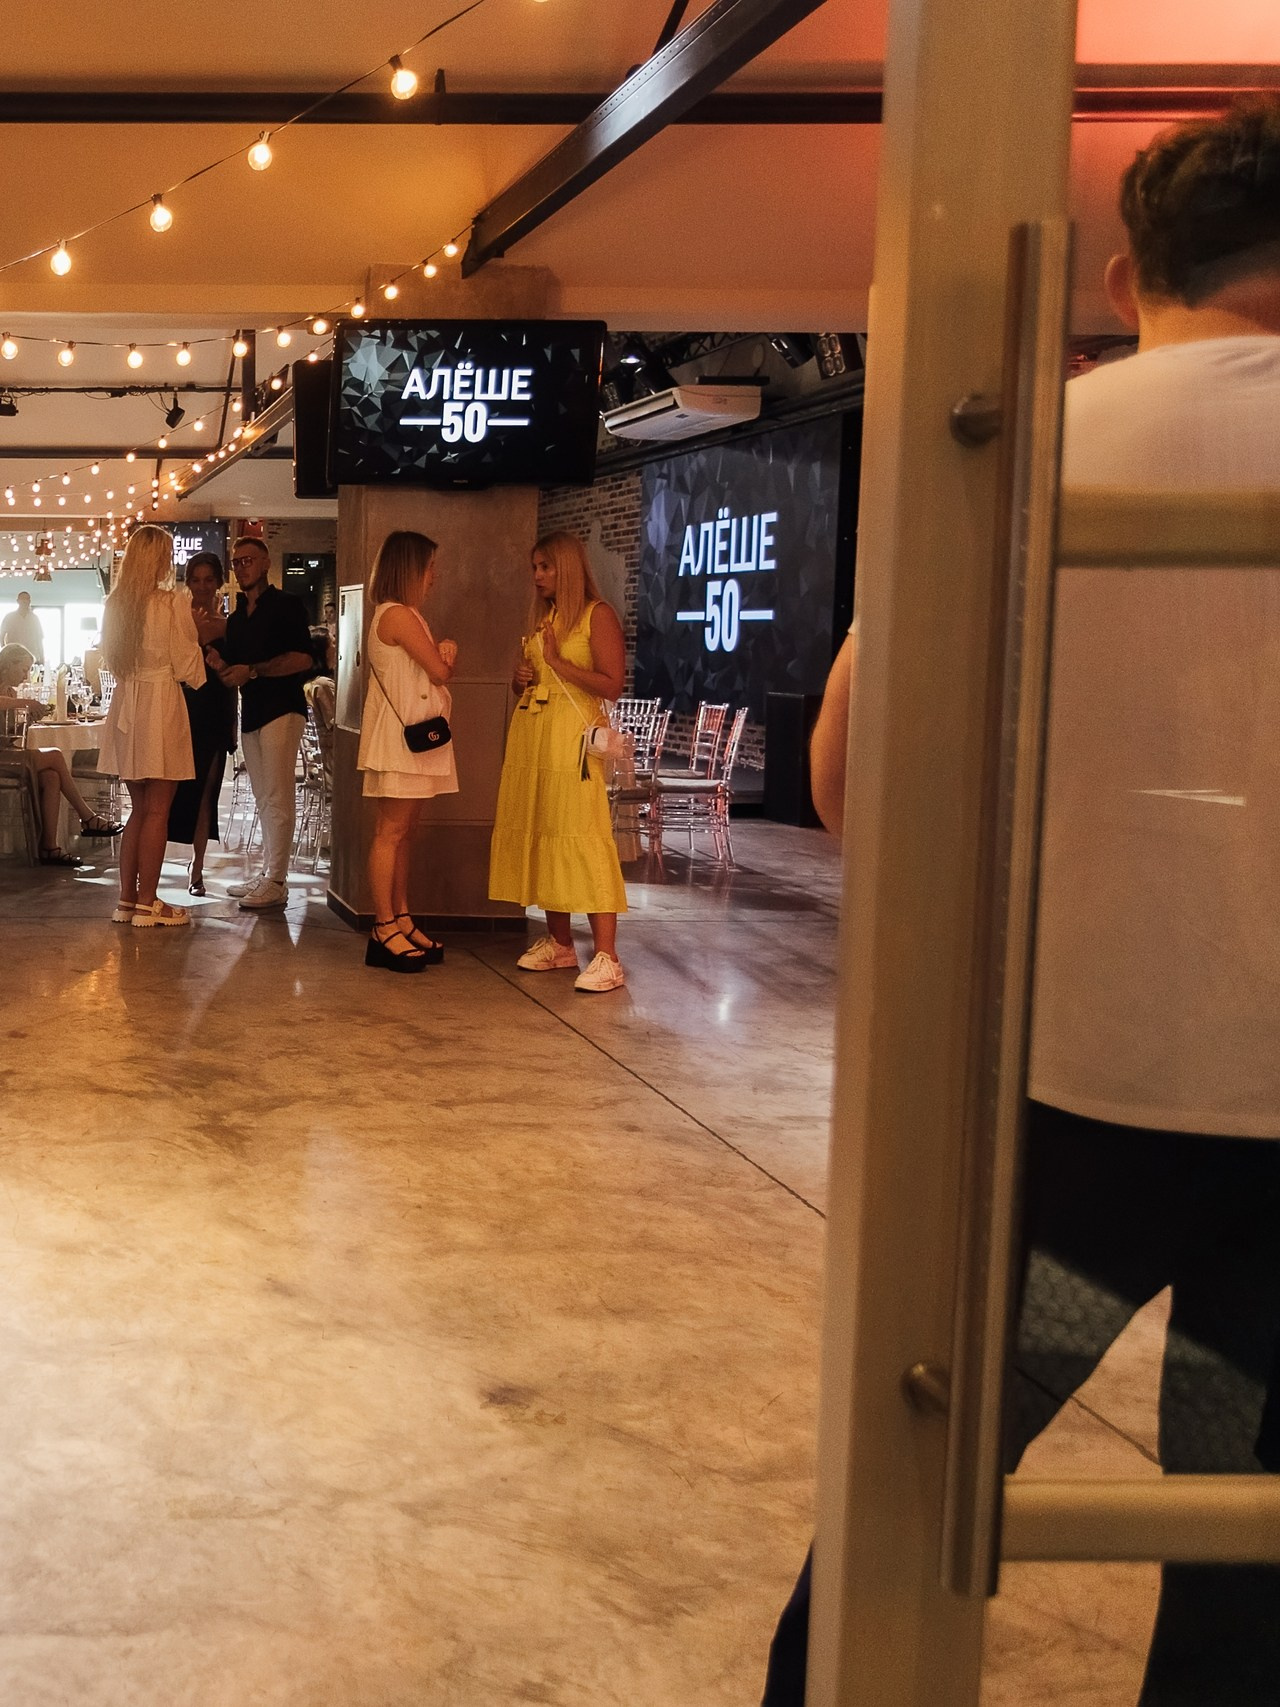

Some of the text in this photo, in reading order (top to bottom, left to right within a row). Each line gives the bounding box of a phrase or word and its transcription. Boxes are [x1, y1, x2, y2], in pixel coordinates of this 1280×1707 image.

[401, 362, 533, 400] АЛЁШЕ
[441, 401, 488, 443] 50
[173, 535, 203, 550] ЁШЕ
[678, 507, 778, 577] АЛЁШЕ
[704, 578, 741, 652] 50
